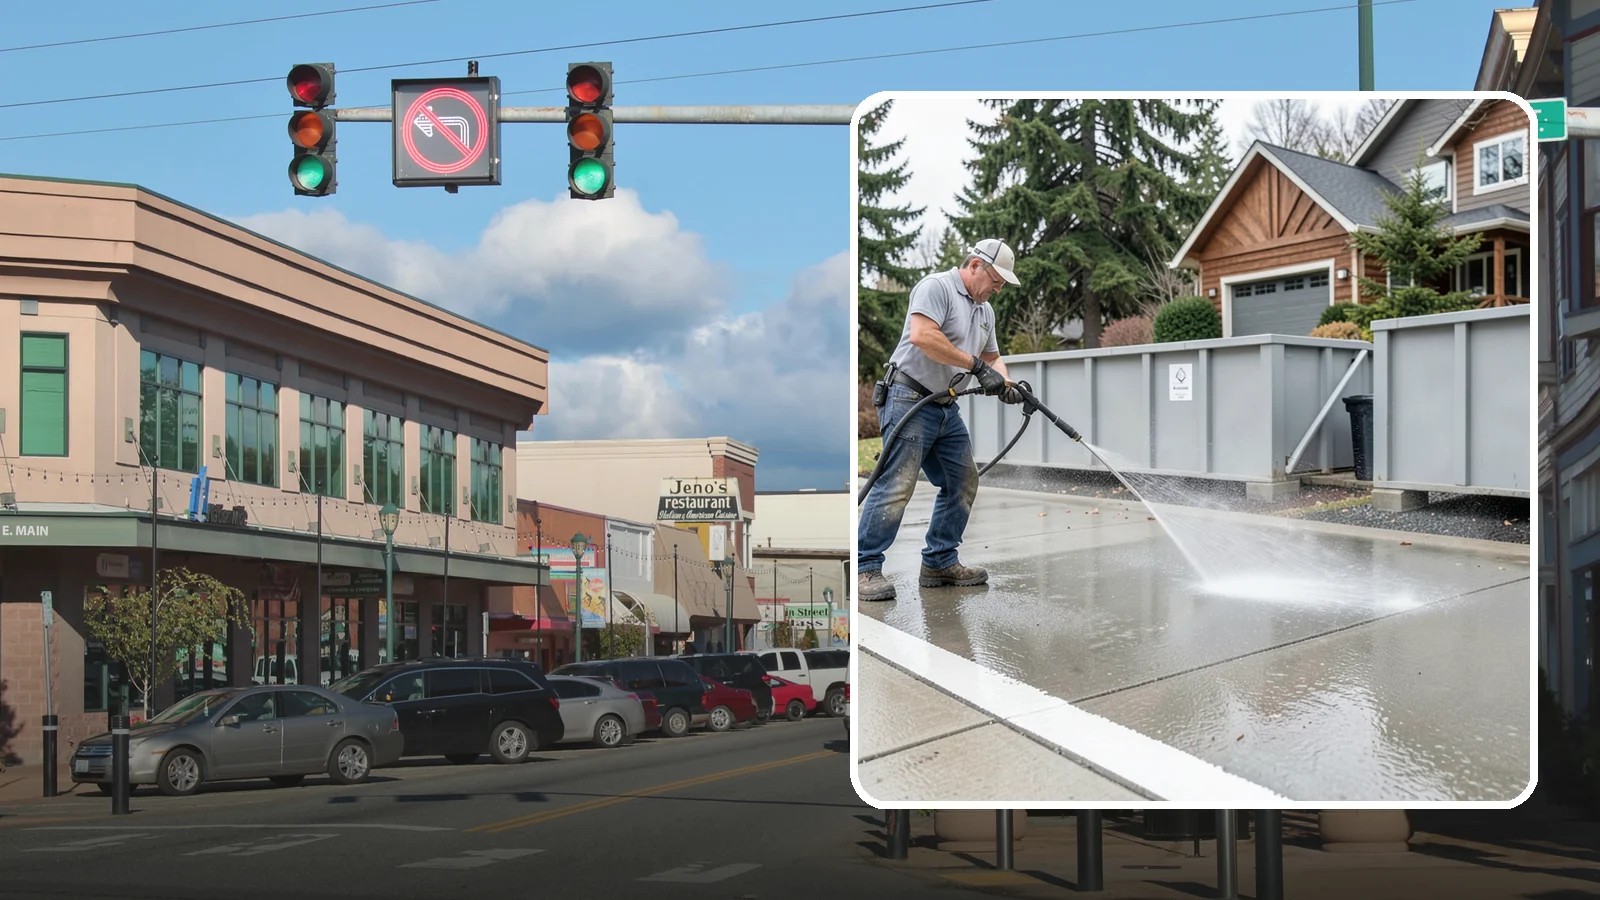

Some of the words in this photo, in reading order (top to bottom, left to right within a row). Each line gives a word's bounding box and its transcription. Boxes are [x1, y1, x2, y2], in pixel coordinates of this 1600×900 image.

[669, 480, 728, 495] Jeno's
[665, 496, 731, 509] restaurant
[685, 509, 715, 519] American
[715, 509, 737, 519] Cuisine
[2, 525, 13, 536] E.
[15, 525, 49, 536] MAIN
[785, 607, 795, 617] in
[797, 607, 828, 617] Street
[791, 619, 824, 627] lass
